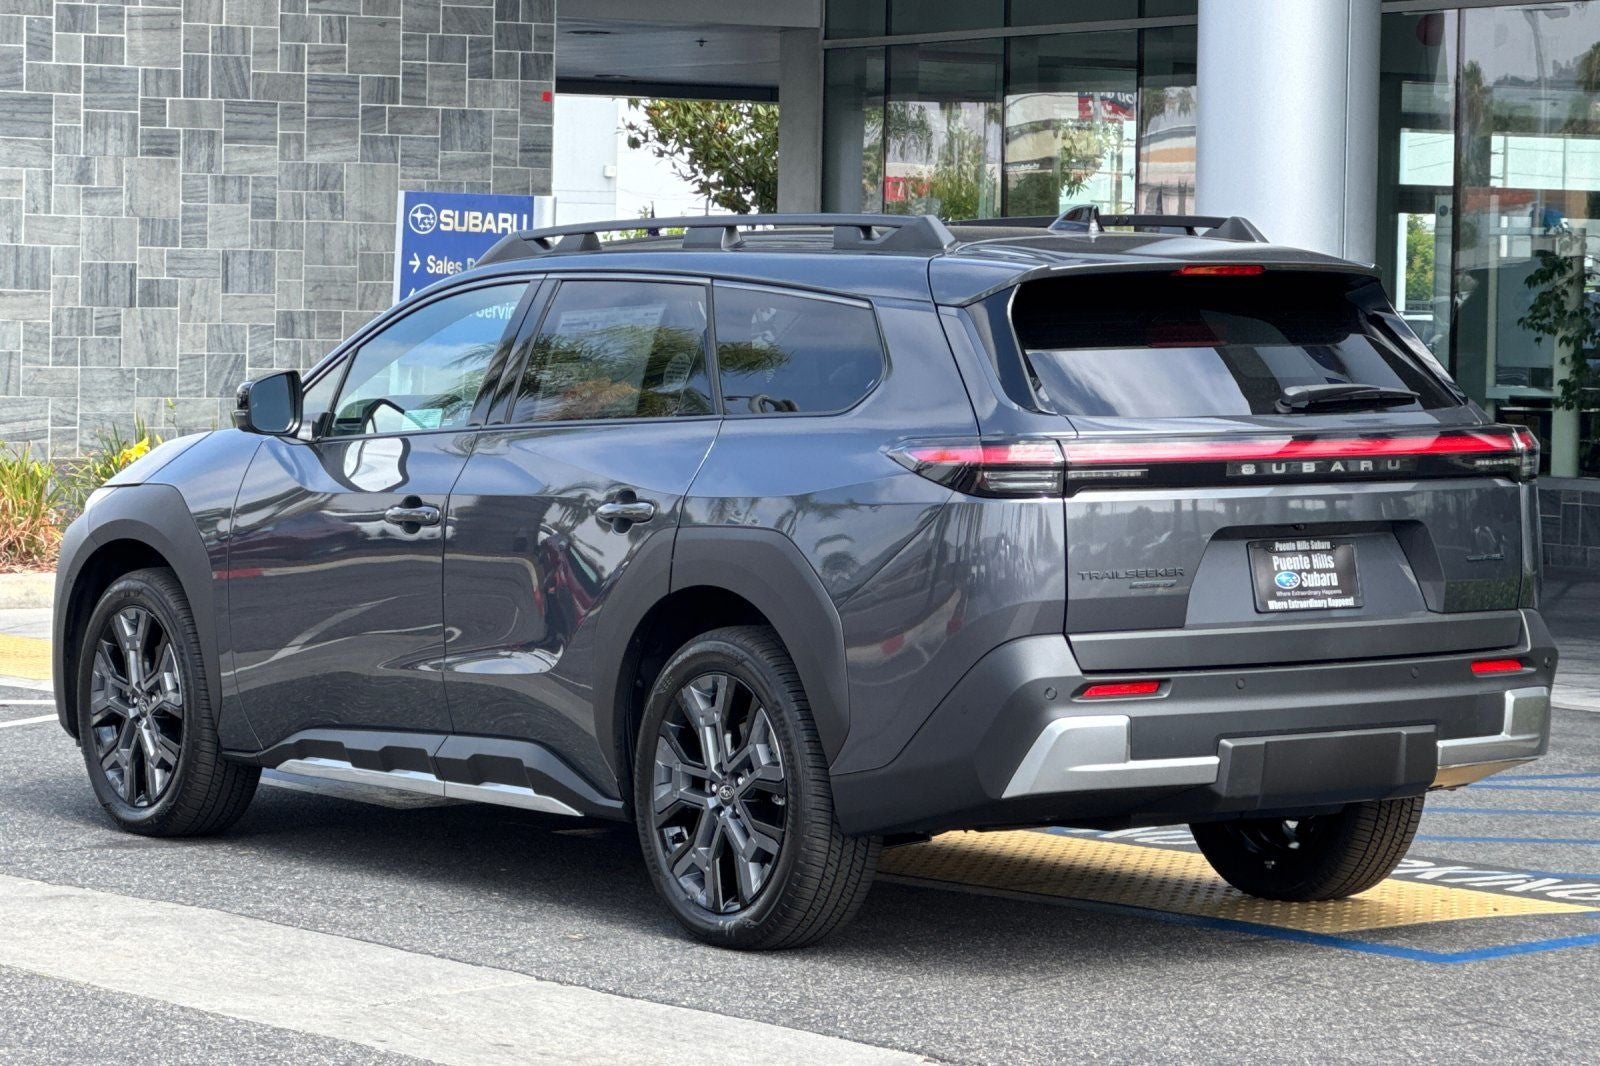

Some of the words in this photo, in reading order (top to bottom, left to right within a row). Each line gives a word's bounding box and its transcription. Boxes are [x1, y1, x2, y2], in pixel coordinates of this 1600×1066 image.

[439, 209, 528, 234] SUBARU
[426, 254, 463, 275] Sales
[1240, 459, 1400, 475] SUBARU
[1275, 542, 1296, 551] Puente
[1297, 541, 1310, 550] Hills
[1310, 541, 1331, 549] Subaru
[1272, 555, 1310, 570] Puente
[1312, 553, 1334, 569] Hills
[1078, 567, 1185, 581] TRAILSEEKER
[1301, 572, 1338, 587] Subaru
[1268, 600, 1288, 609] Where
[1288, 598, 1328, 609] Extraordinary
